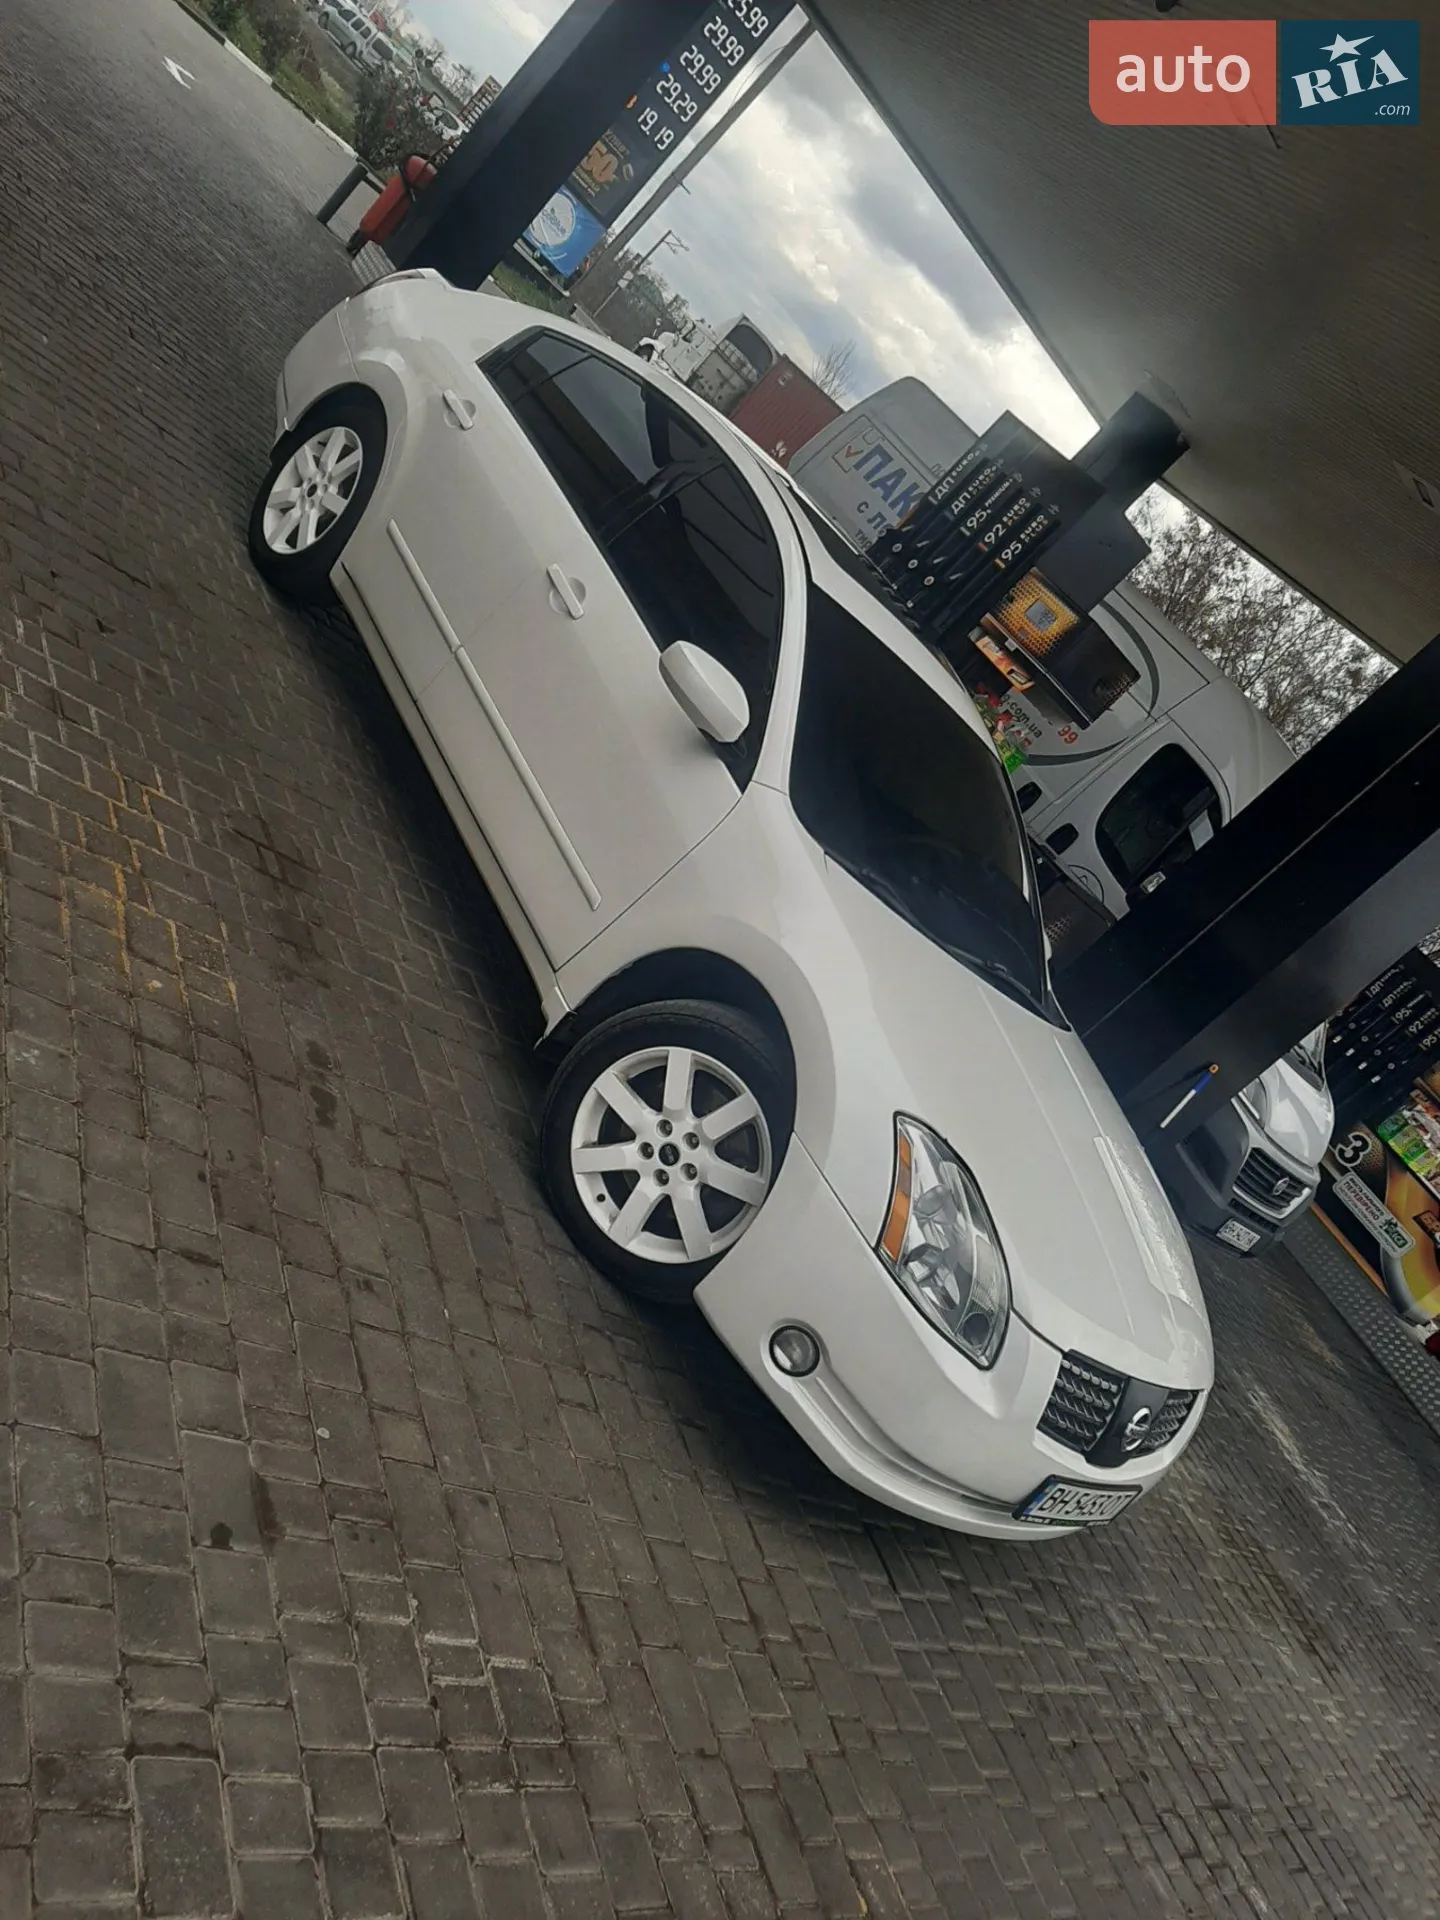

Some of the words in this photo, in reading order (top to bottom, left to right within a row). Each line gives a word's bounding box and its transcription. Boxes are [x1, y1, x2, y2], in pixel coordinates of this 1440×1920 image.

[703, 15, 745, 66] 29.99
[680, 44, 721, 94] 29.99
[656, 73, 698, 122] 29.29
[934, 475, 955, 499] ДП
[951, 452, 974, 477] EURO
[951, 491, 971, 515] ДП
[968, 468, 990, 491] EURO
[984, 523, 1007, 544] 92
[1002, 497, 1026, 522] EURO
[1007, 501, 1031, 526] PLUS
[1024, 519, 1048, 543] PLUS
[1001, 540, 1022, 561] 95
[1020, 514, 1044, 539] EURO
[1408, 1020, 1424, 1034] 92
[1422, 1034, 1437, 1048] 95
[1336, 1132, 1372, 1167] 3
